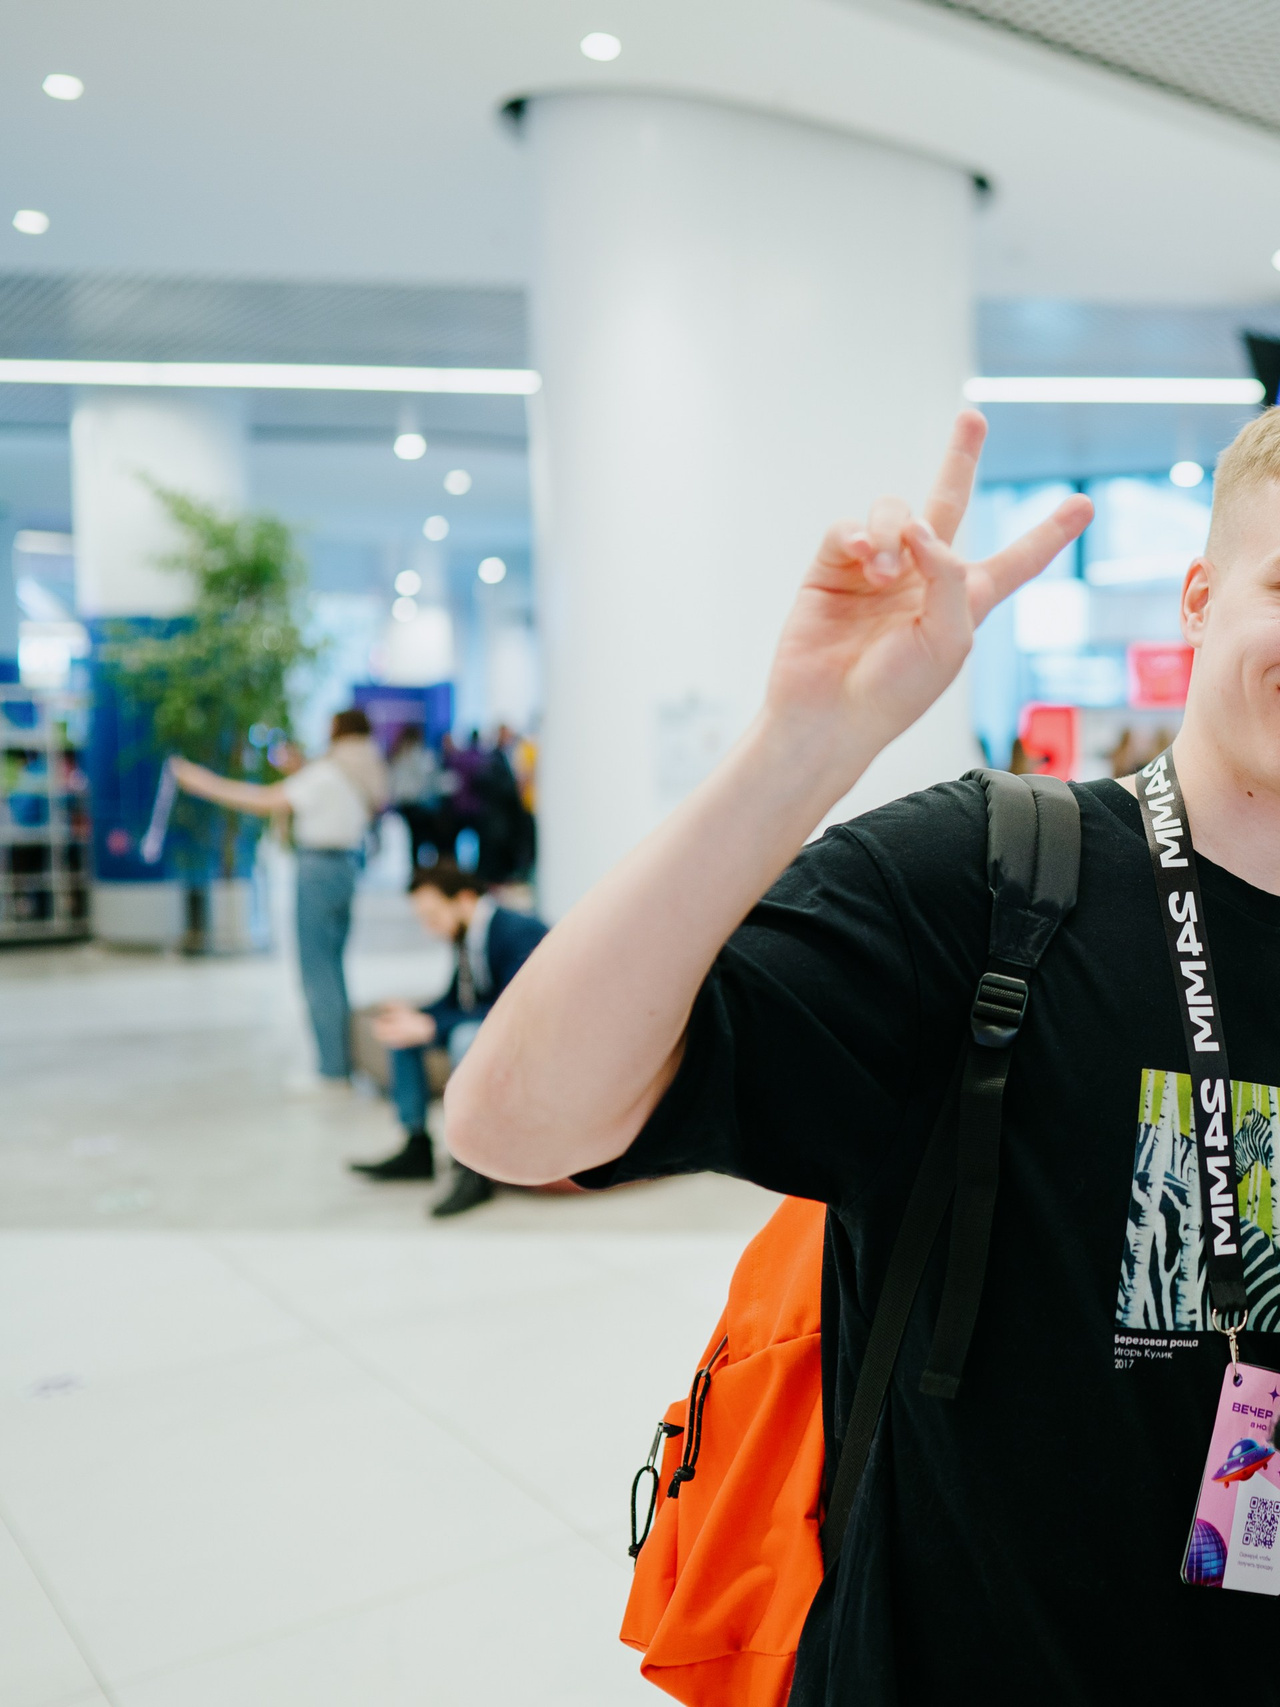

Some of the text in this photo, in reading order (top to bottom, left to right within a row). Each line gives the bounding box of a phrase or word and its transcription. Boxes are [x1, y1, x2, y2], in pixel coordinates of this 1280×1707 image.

[1114, 1334, 1199, 1349] Березовая роща
[1114, 1347, 1173, 1359] Игорь Кулик
[1114, 1359, 1134, 1369] 2017
[1232, 1402, 1273, 1420] ВЕЧЕР
